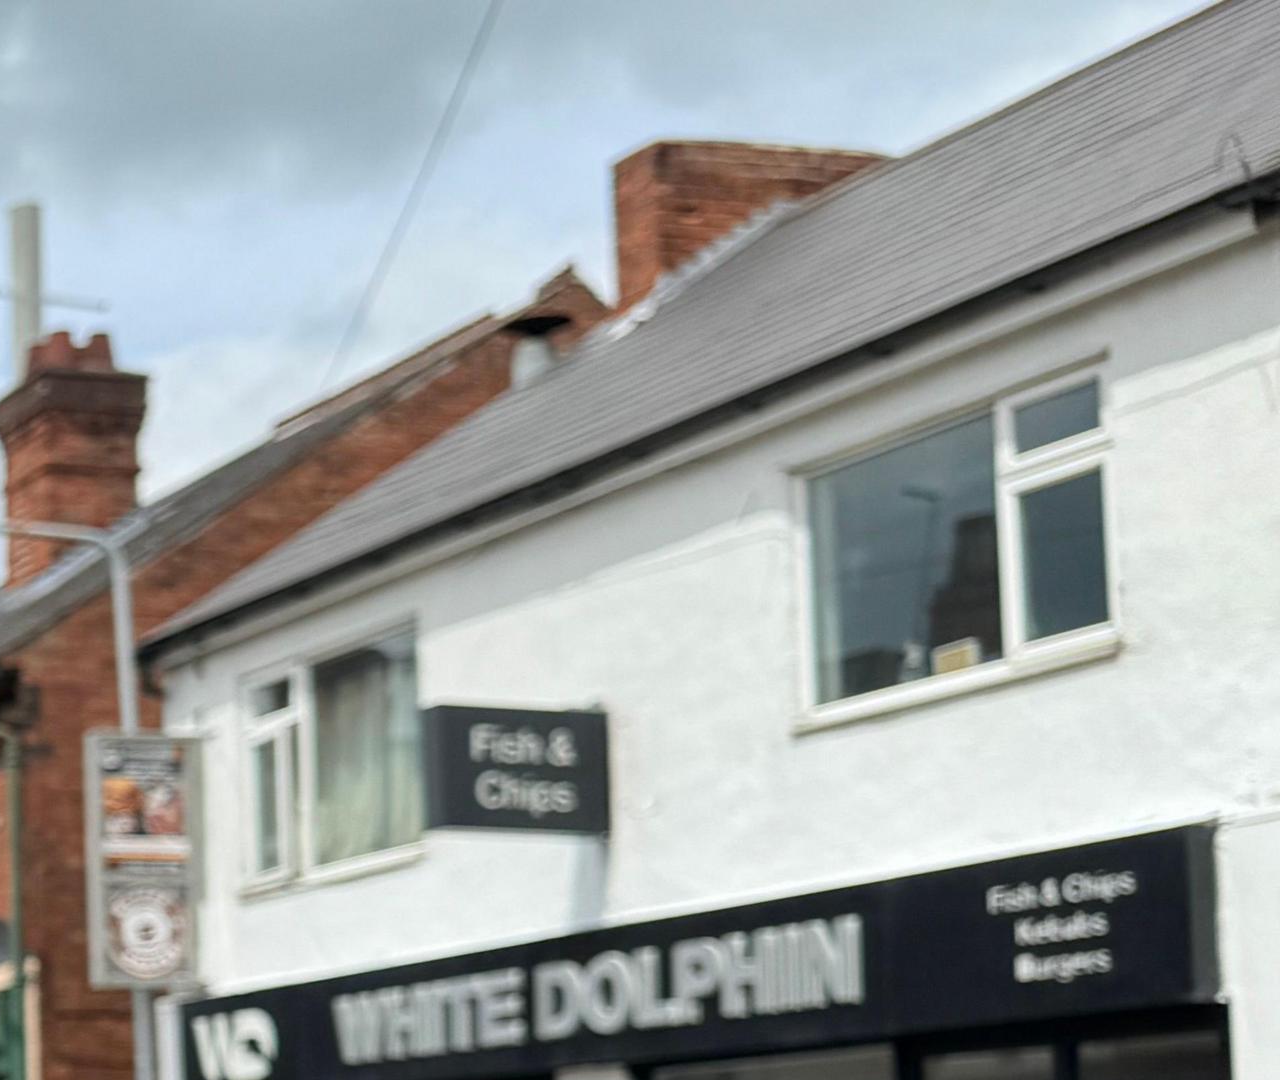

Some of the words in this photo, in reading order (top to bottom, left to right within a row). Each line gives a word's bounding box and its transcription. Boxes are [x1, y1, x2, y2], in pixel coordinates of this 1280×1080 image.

[469, 722, 545, 765] Fish
[545, 726, 579, 767] &
[474, 769, 580, 818] Chips
[985, 881, 1039, 916] Fish
[1039, 876, 1062, 907] &
[1061, 869, 1138, 904] Chips
[1013, 909, 1111, 947] Kebabs
[331, 965, 528, 1066] WHITE
[531, 912, 865, 1042] DOLPHIN
[1013, 948, 1113, 984] Burgers
